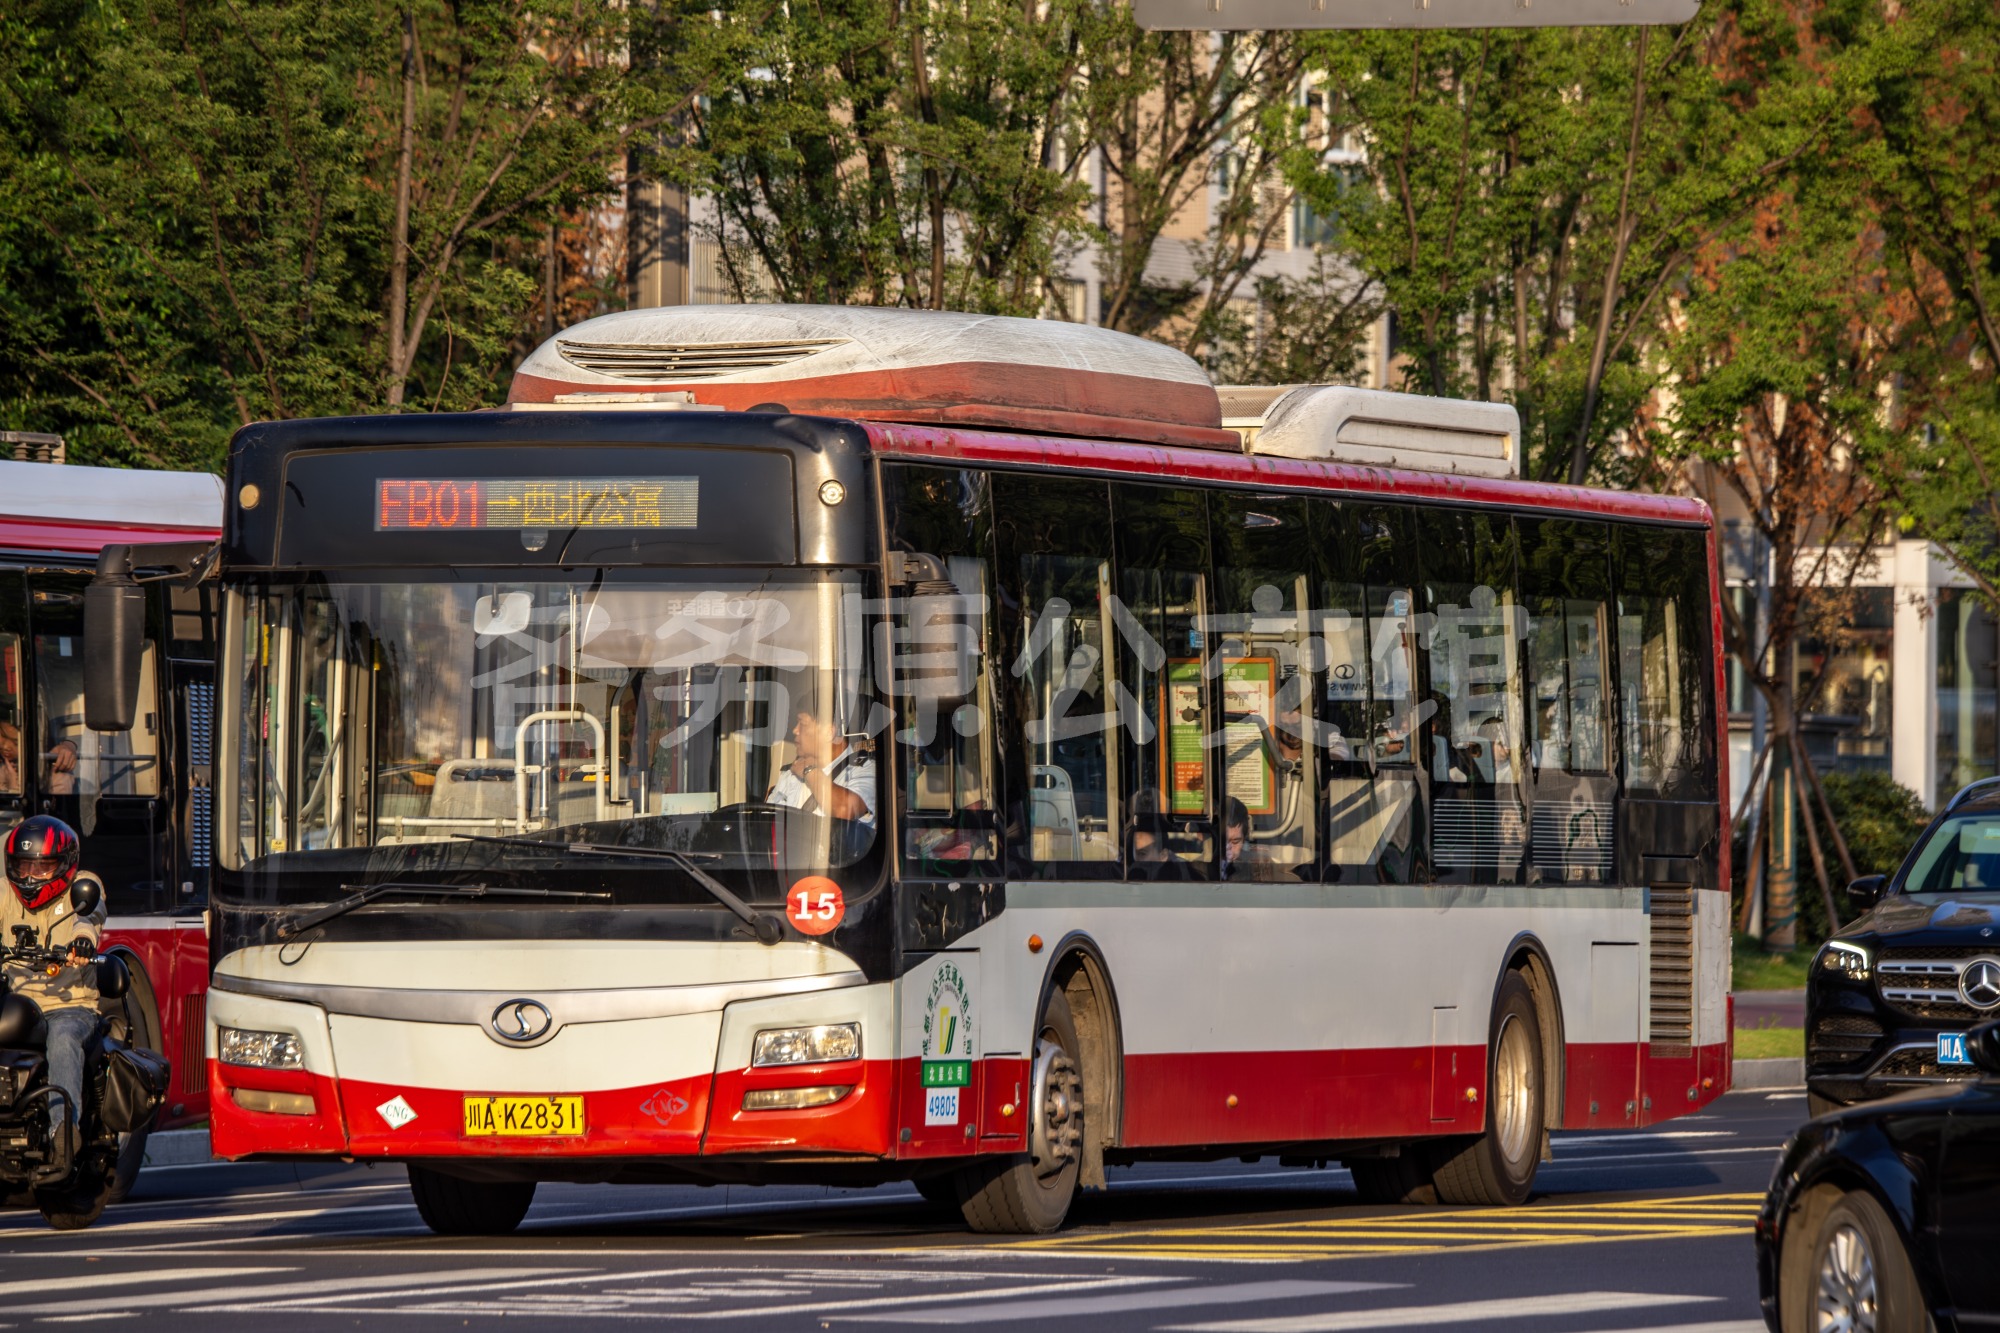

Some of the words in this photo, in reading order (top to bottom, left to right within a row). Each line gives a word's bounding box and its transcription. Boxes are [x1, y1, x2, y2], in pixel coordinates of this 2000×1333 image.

[382, 481, 477, 527] FB01
[524, 481, 664, 527] 西北公寓
[795, 892, 836, 920] 15
[385, 1104, 409, 1120] CNG
[928, 1095, 956, 1117] 49805
